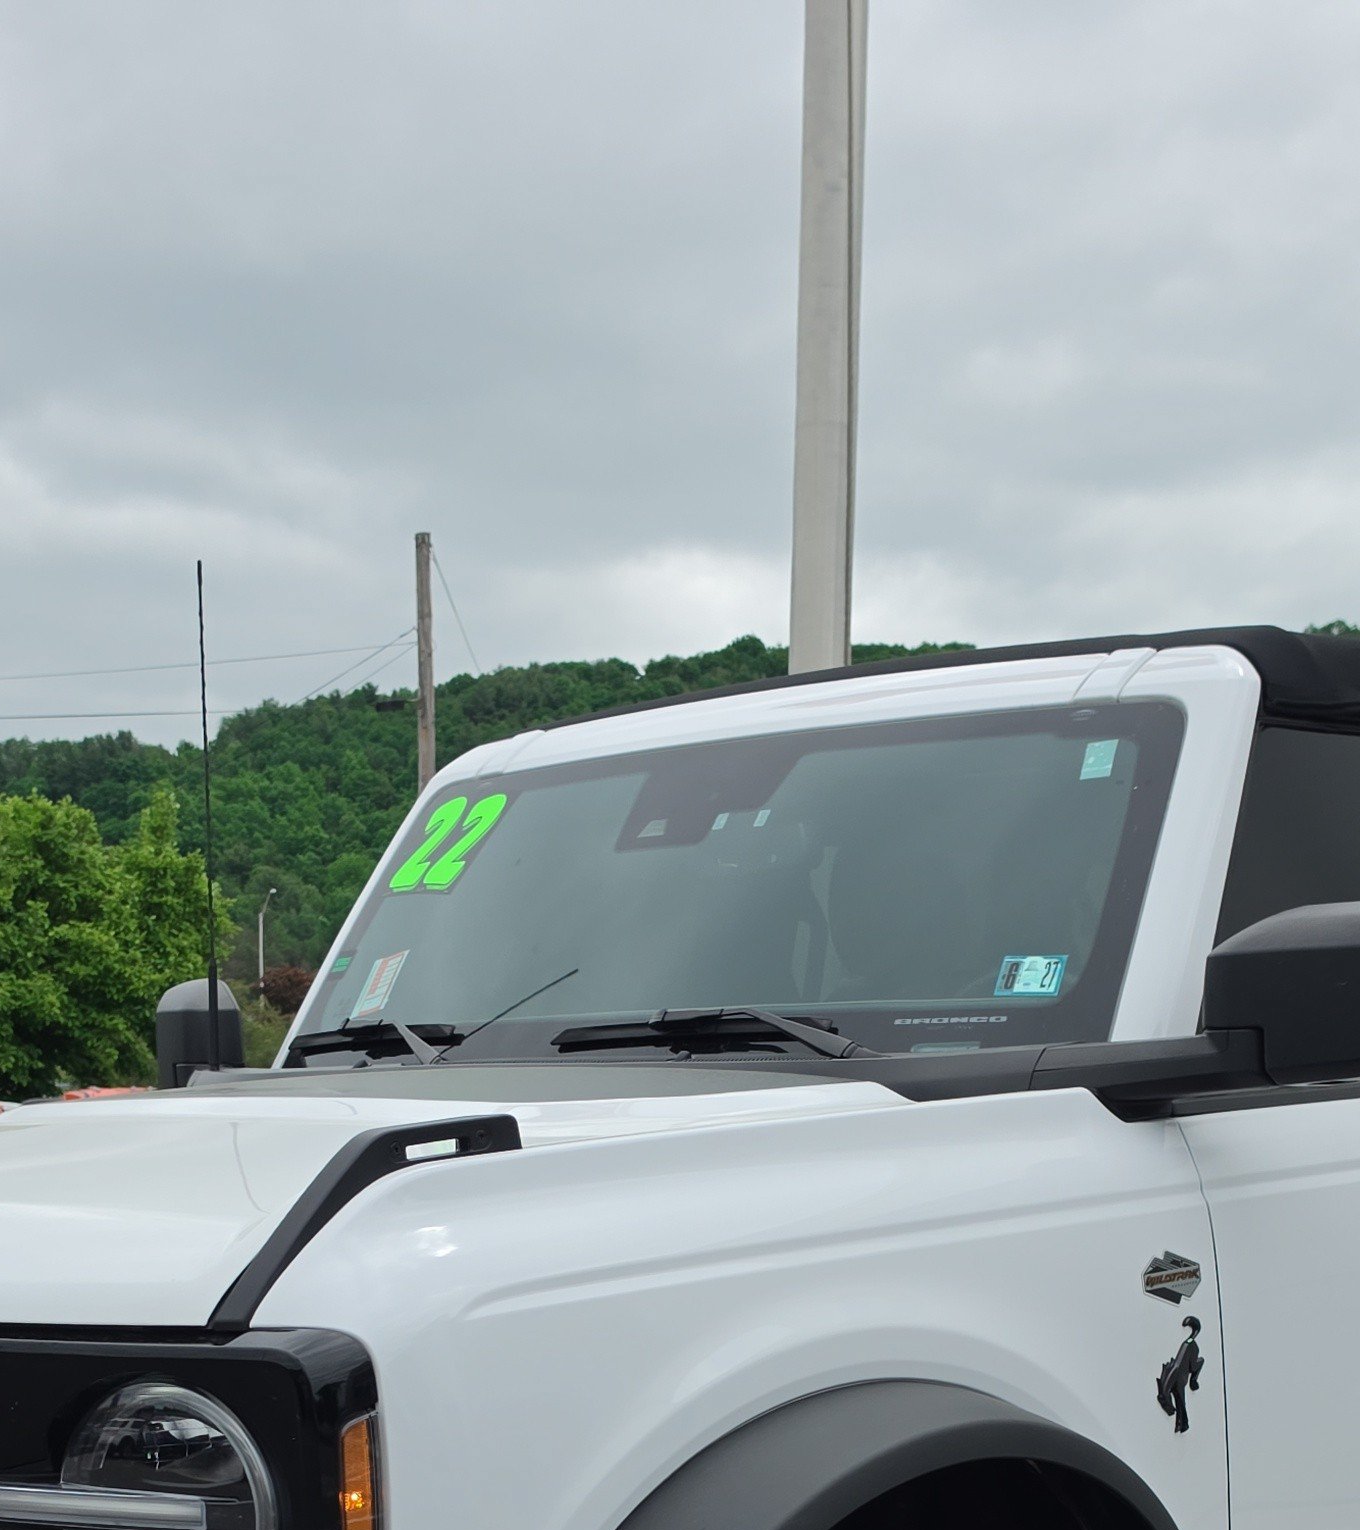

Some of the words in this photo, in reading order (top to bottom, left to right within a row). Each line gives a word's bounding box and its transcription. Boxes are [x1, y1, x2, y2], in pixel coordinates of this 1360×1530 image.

[388, 793, 507, 893] 22
[1003, 961, 1021, 990] 6
[1038, 961, 1060, 990] 27
[893, 1014, 1008, 1026] BRONCO
[1145, 1268, 1200, 1288] WILDTRAK
